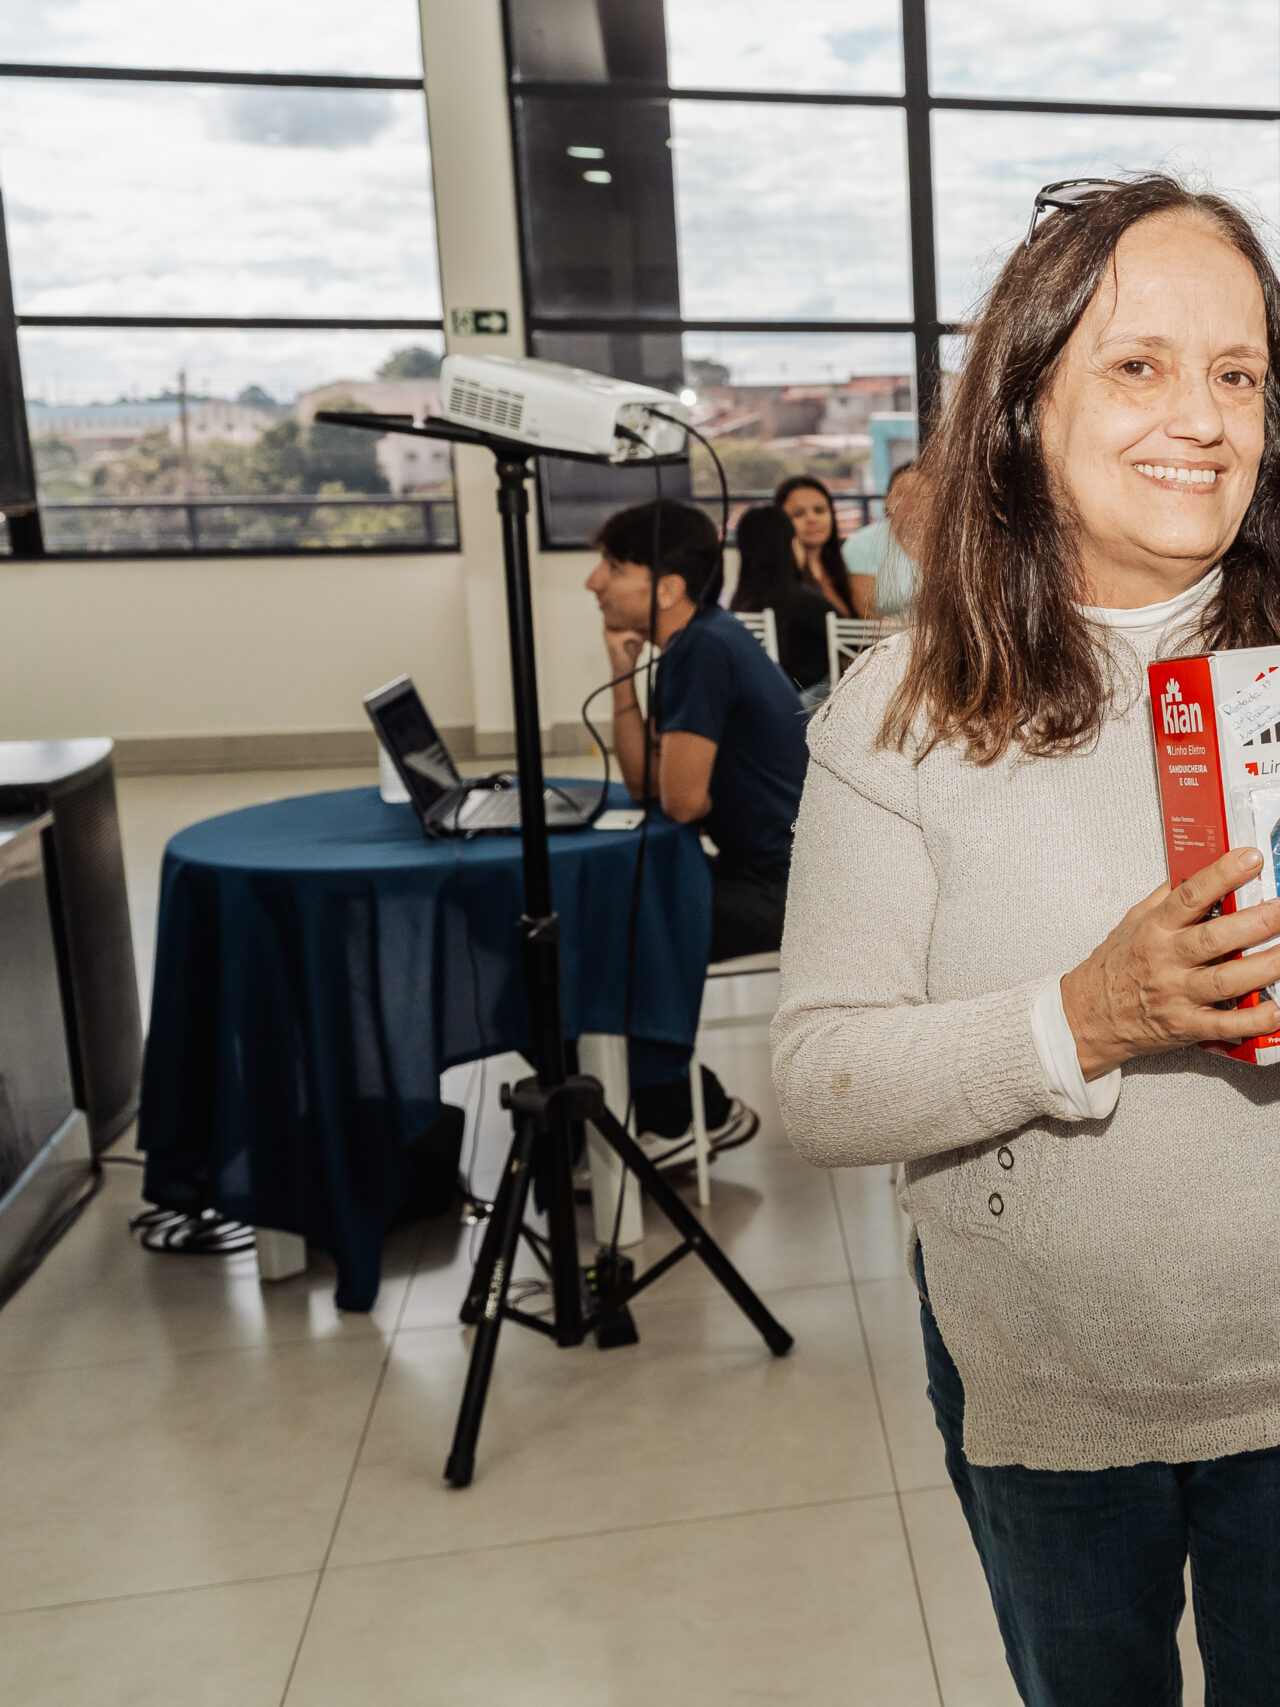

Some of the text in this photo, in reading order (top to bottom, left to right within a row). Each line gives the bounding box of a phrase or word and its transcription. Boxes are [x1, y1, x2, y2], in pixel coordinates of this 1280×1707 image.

[1160, 693, 1203, 734] kian
[1171, 745, 1206, 756] Linha Eletro
[1168, 764, 1208, 774] SANDUICHEIRA
[1184, 777, 1200, 786] GRILL
